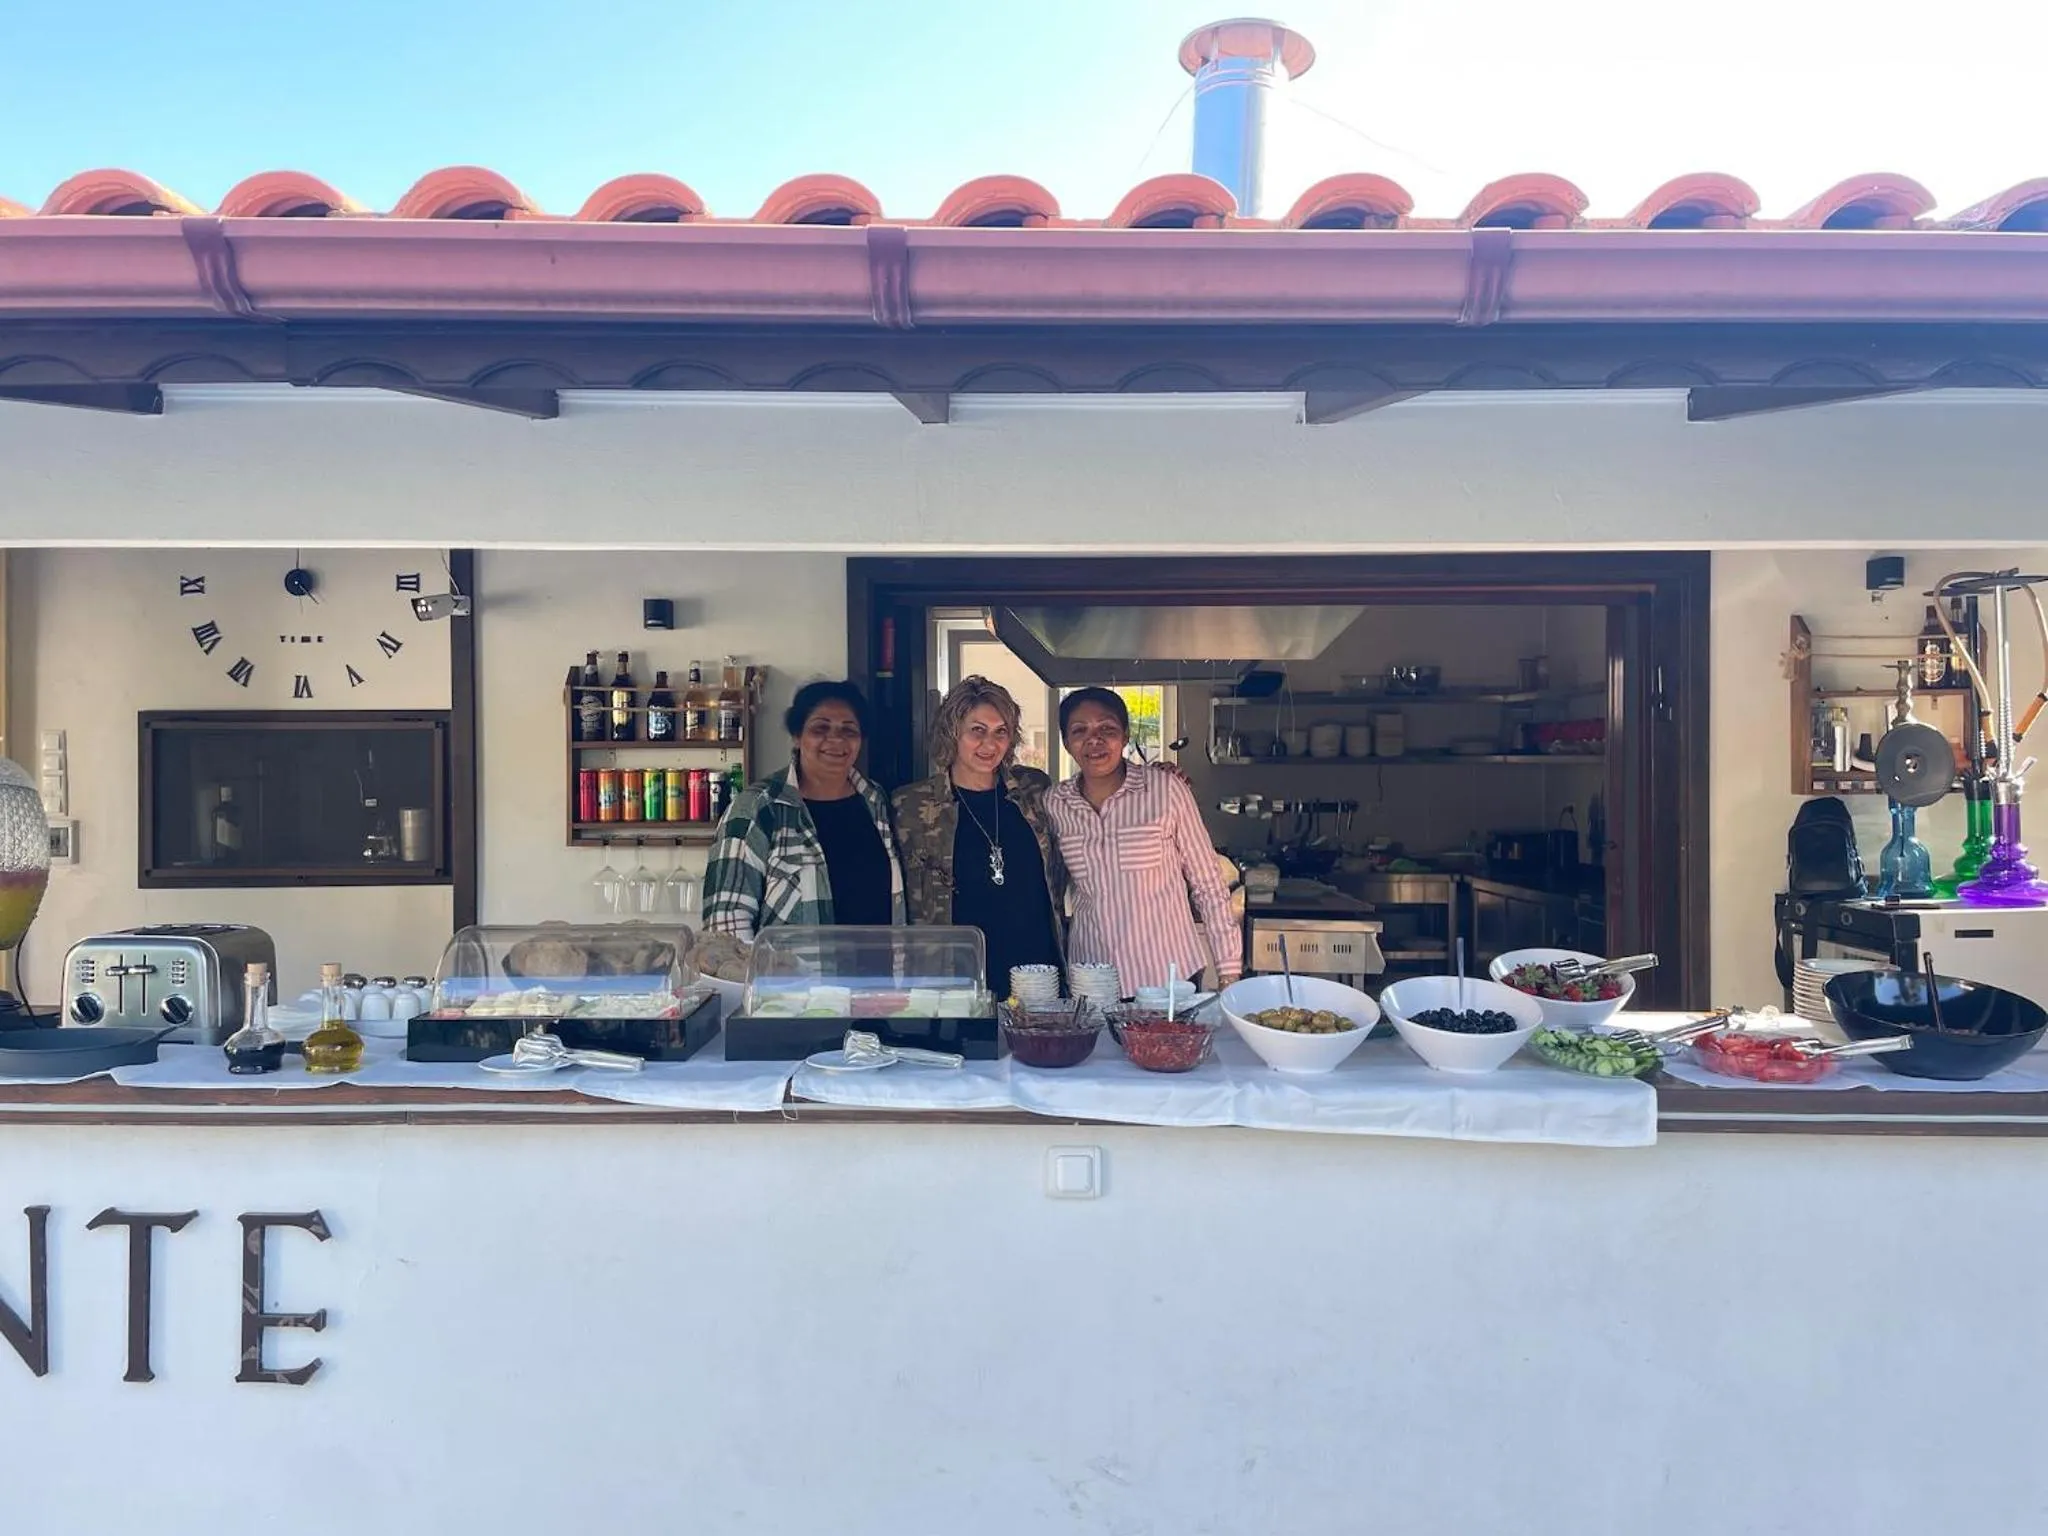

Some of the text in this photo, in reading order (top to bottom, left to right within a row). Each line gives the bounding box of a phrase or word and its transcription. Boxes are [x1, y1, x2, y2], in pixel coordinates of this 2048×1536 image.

[180, 575, 206, 596] IX
[396, 573, 421, 593] III
[191, 620, 222, 655] VIII
[280, 635, 324, 643] TIME
[292, 674, 313, 698] VI
[345, 664, 365, 687] V
